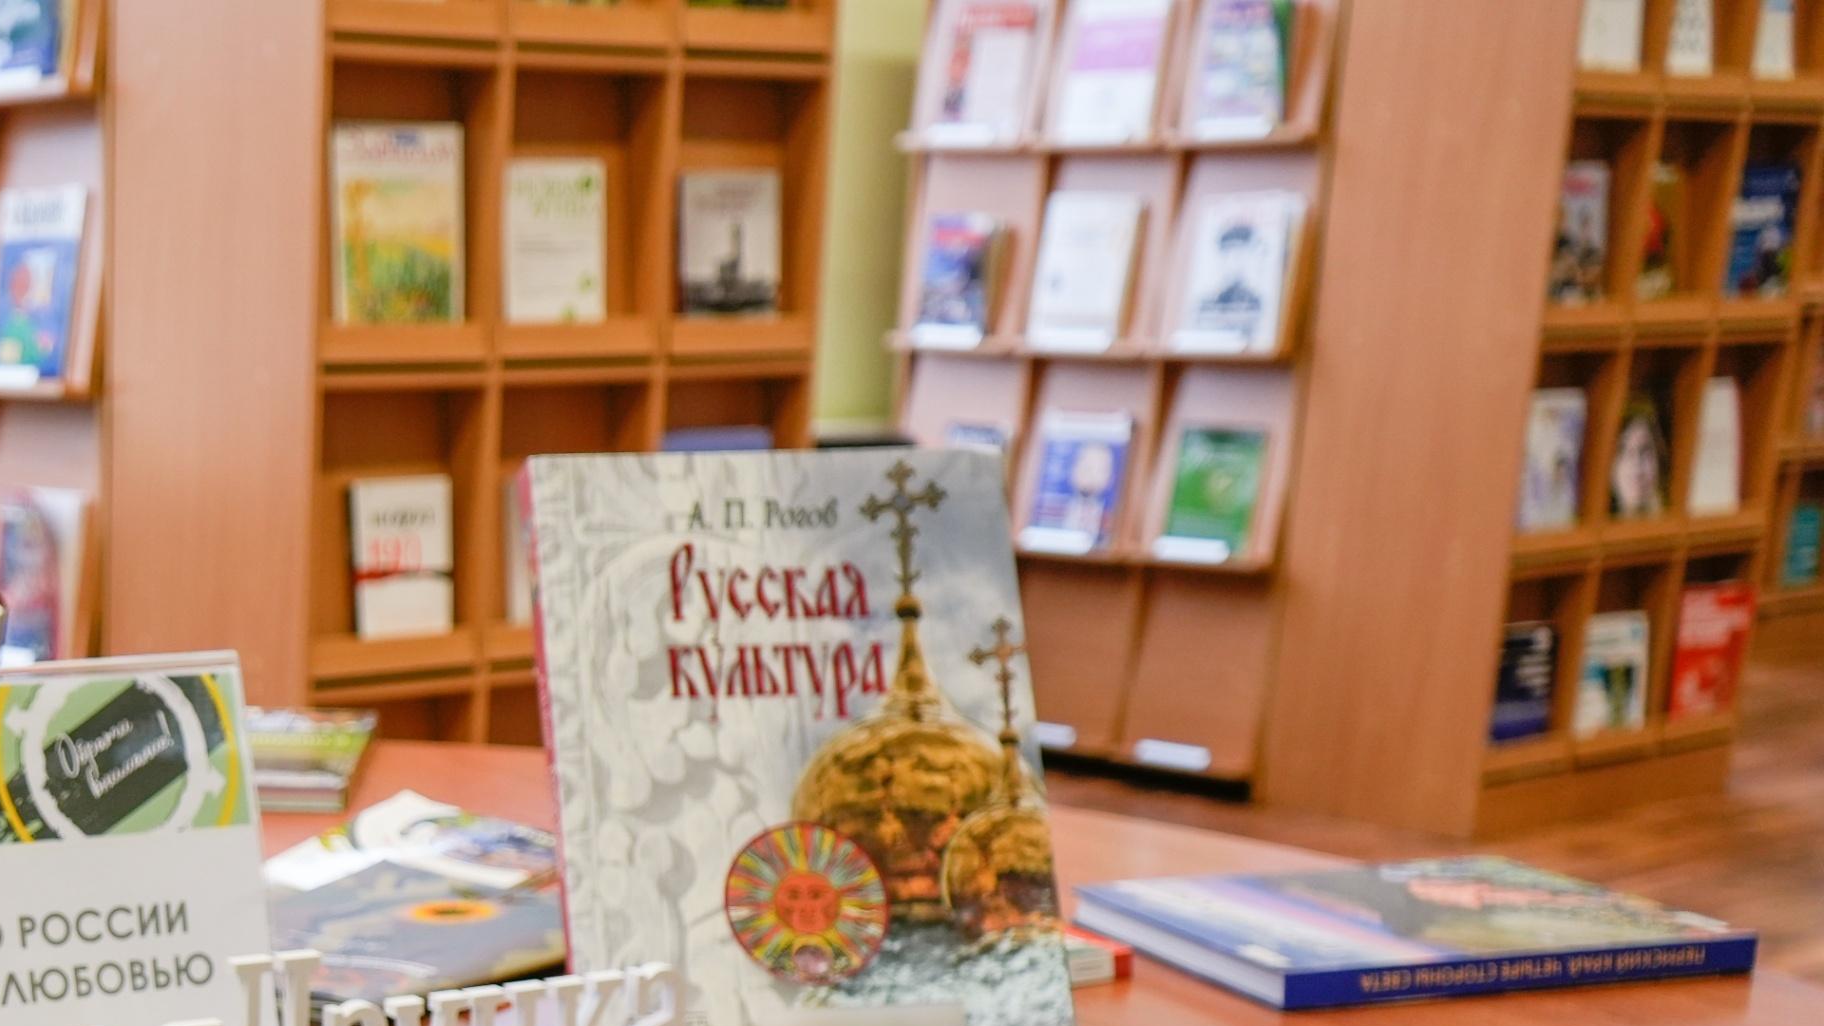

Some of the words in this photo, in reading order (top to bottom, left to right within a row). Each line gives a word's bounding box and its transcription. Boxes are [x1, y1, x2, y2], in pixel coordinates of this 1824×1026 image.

[688, 500, 713, 530] А.
[724, 497, 754, 530] П.
[764, 497, 839, 531] Рогов
[20, 901, 190, 948] РОССИИ
[1, 951, 214, 1007] ЛЮБОВЬЮ
[1360, 971, 1412, 994] СВЕТА
[1499, 957, 1563, 984] ЧЕТЫРЕ
